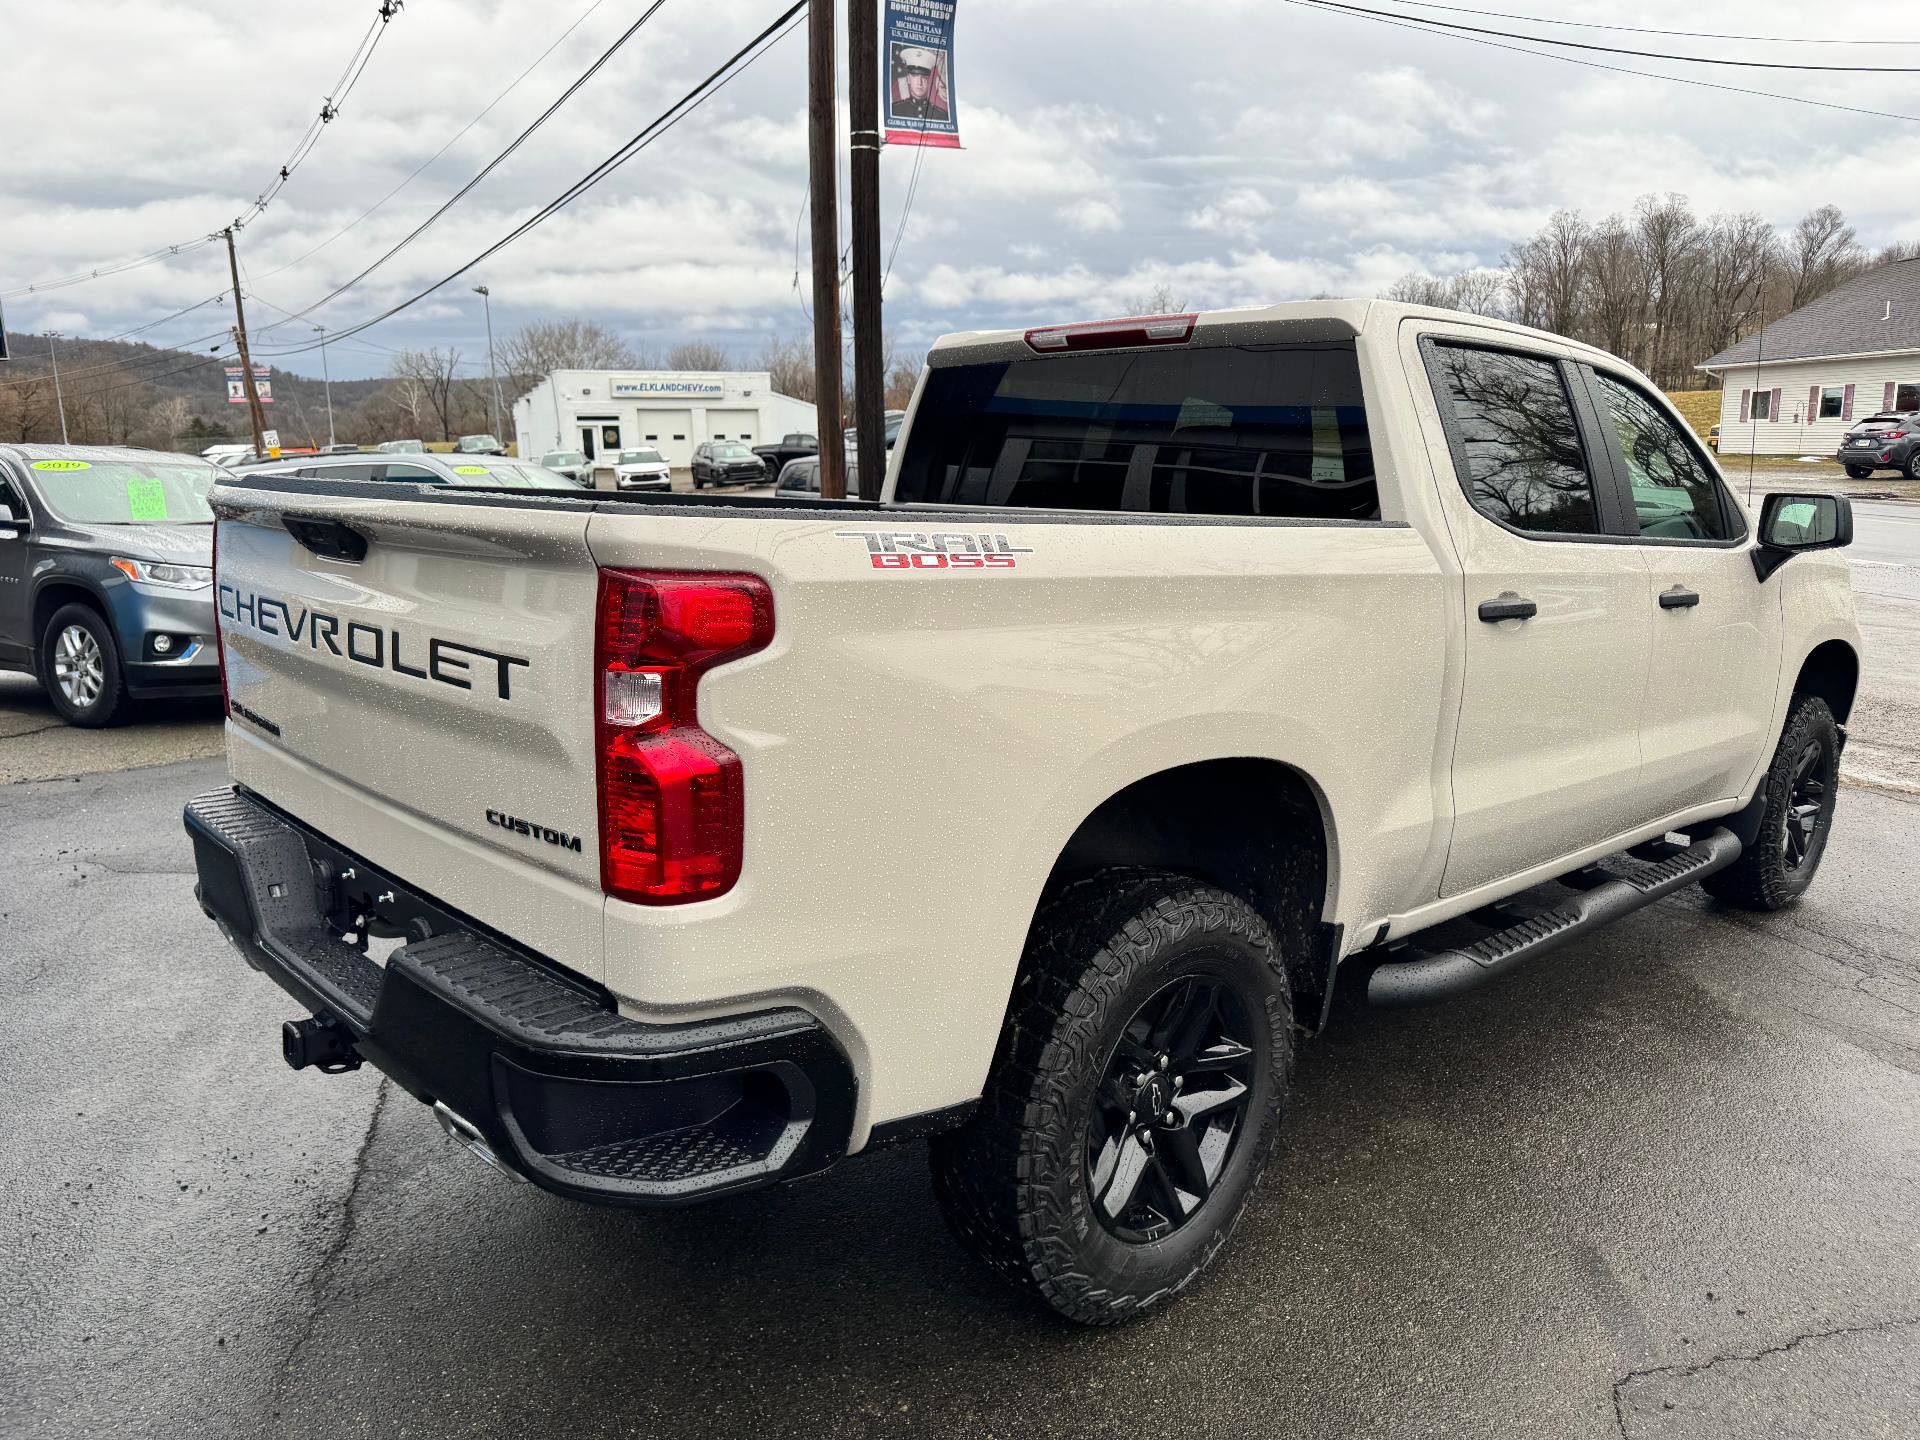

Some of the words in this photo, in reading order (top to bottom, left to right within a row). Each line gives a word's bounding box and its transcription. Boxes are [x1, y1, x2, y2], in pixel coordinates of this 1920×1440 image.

[890, 1, 930, 17] HOMETOWN
[931, 10, 951, 21] HERO
[895, 20, 923, 32] MICHAEL
[903, 31, 927, 42] MARINE
[616, 382, 722, 392] www.ELKLANDCHEVY.com
[42, 462, 81, 470] 2019
[833, 531, 1034, 554] TRAIL
[869, 552, 1017, 570] BOSS
[218, 584, 530, 701] CHEVROLET
[485, 807, 582, 853] CUSTOM
